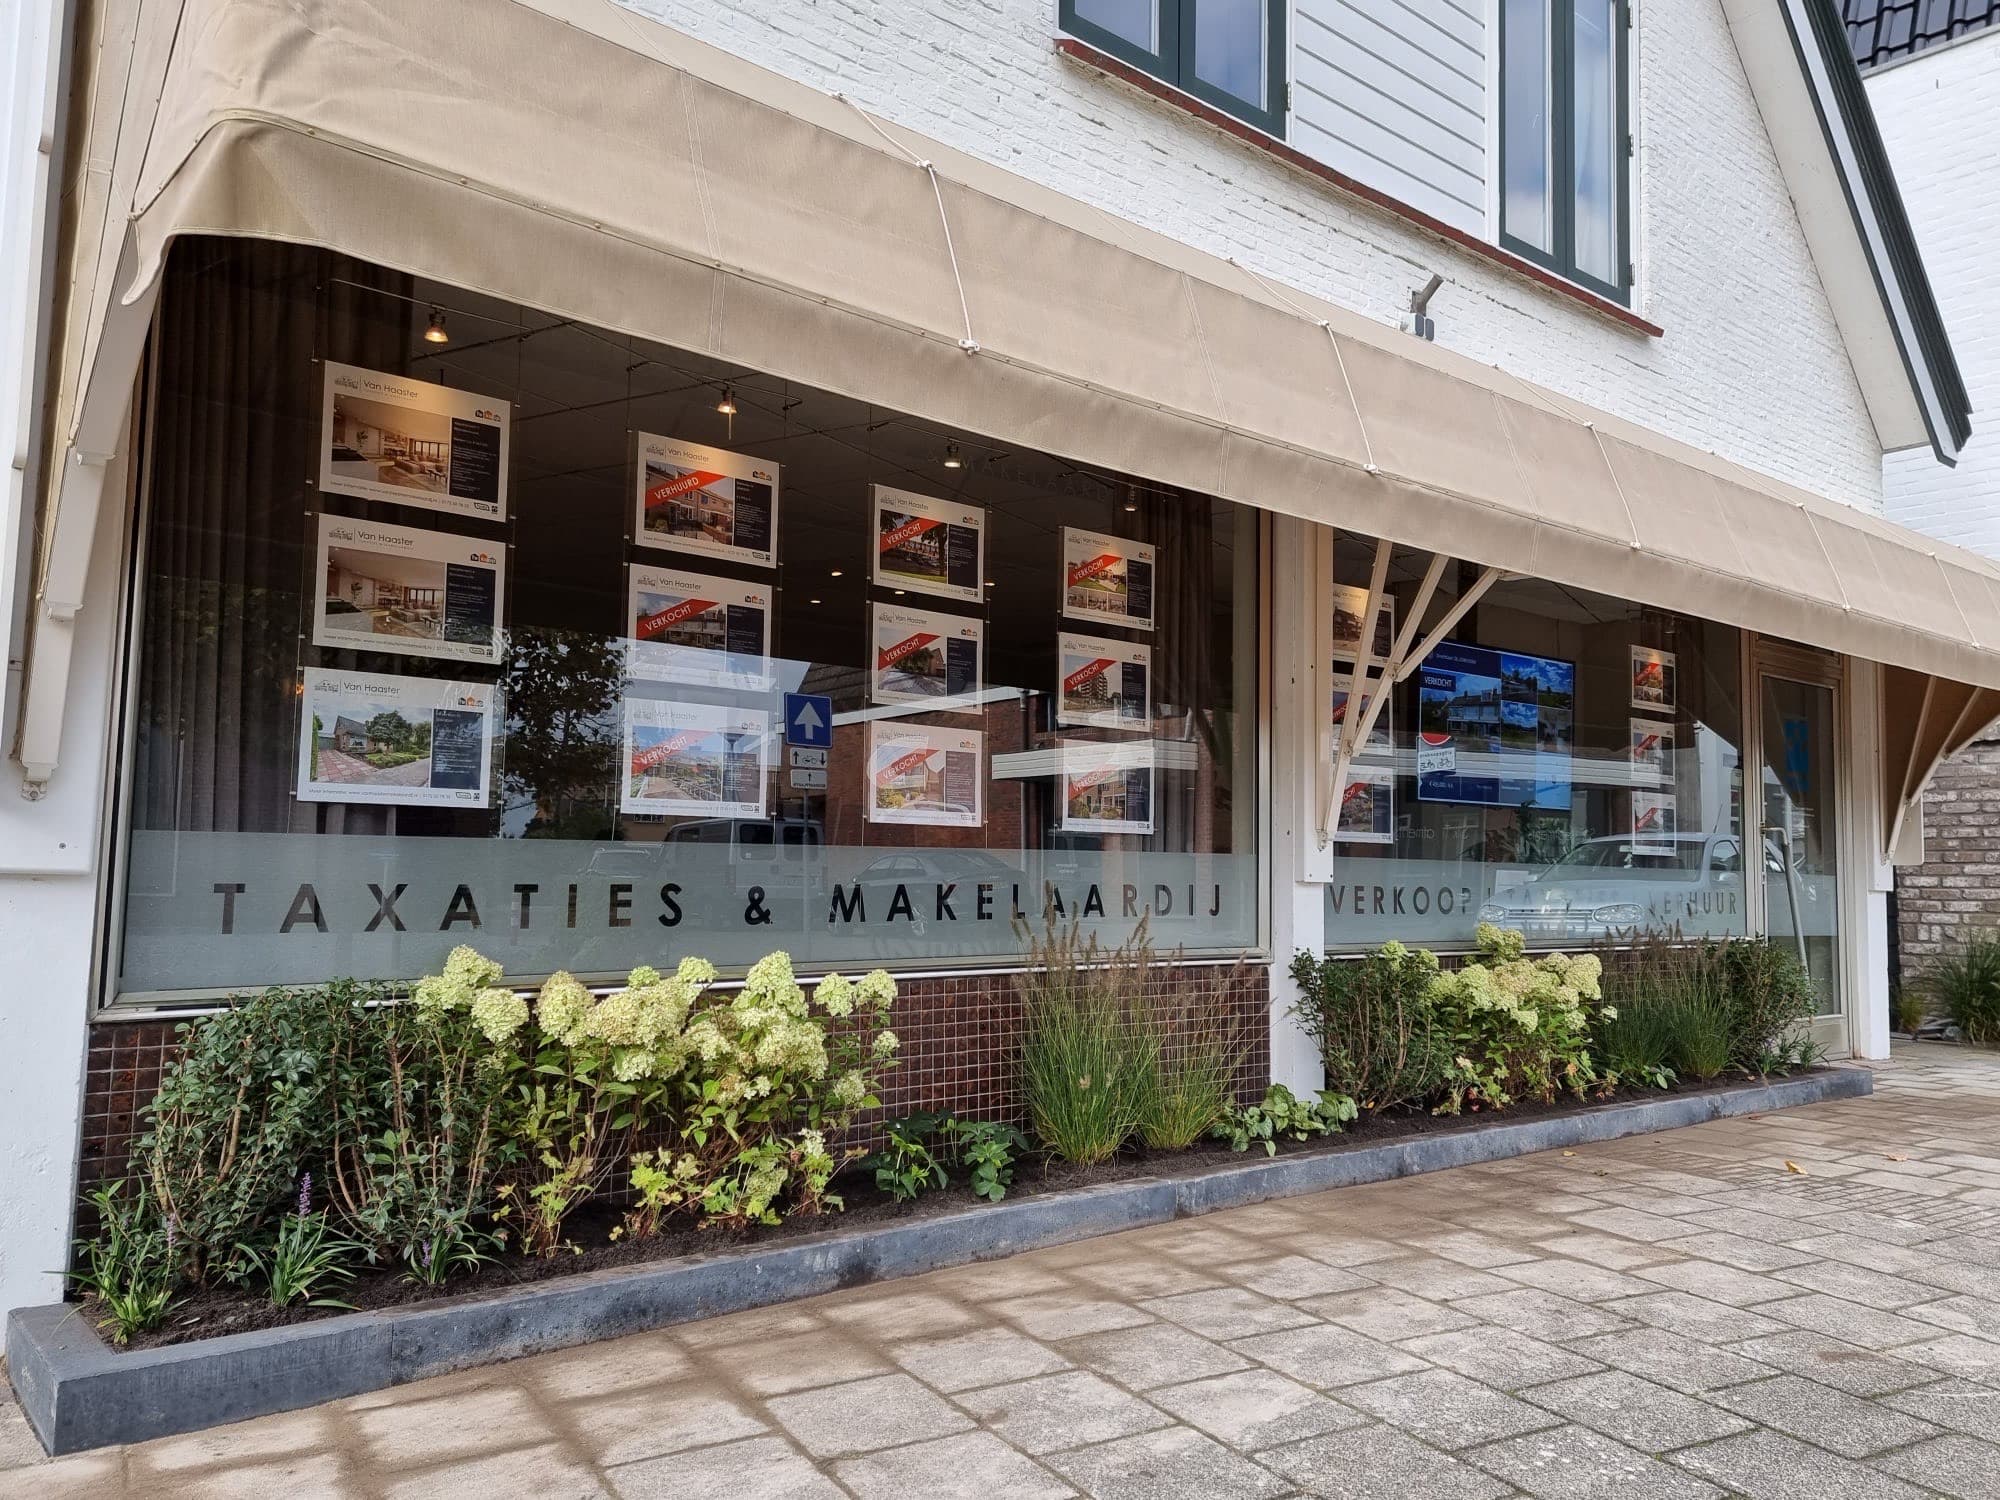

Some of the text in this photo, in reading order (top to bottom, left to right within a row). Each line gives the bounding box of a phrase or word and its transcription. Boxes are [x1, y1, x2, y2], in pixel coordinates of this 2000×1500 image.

[363, 380, 382, 390] Van
[384, 384, 419, 399] Haaster
[666, 448, 710, 463] Van Haaster
[654, 476, 700, 501] VERHUURD
[358, 531, 376, 541] Van
[378, 534, 413, 546] Haaster
[886, 522, 921, 545] VERKOCHT
[1073, 559, 1105, 580] VERKOCHT
[658, 578, 702, 590] Van Haaster
[644, 604, 693, 631] VERKOCHT
[884, 638, 920, 661] VERKOCHT
[1068, 663, 1100, 685] VERKOCHT
[1424, 675, 1453, 688] VERKOCHT
[343, 682, 401, 694] Van Haaster
[640, 736, 688, 765] VERKOCHT
[883, 753, 919, 780] VERKOCHT
[213, 882, 1222, 935] TAXATIES & MAKELAARDIJ
[1329, 885, 1472, 915] VERKOOP
